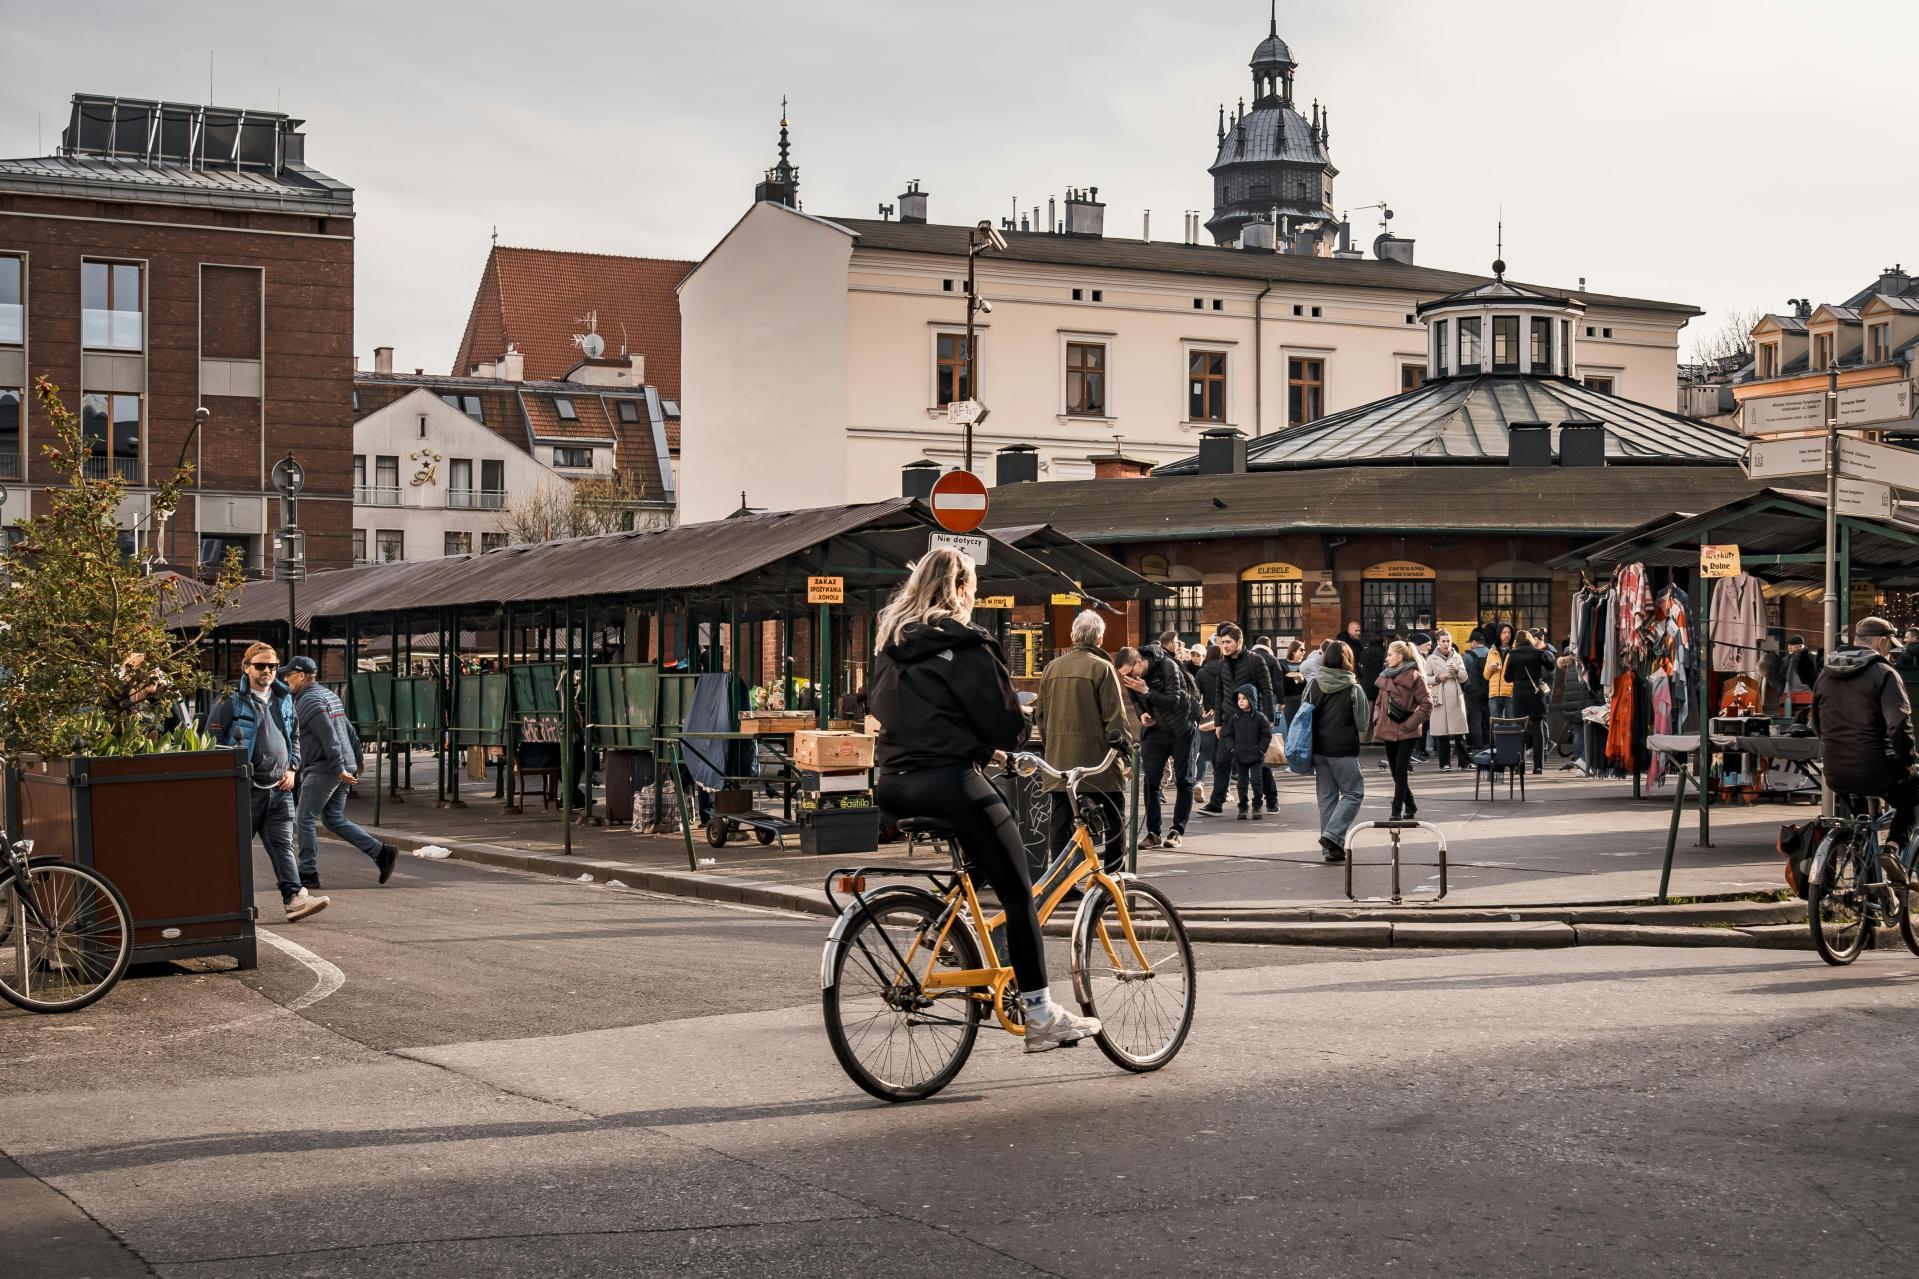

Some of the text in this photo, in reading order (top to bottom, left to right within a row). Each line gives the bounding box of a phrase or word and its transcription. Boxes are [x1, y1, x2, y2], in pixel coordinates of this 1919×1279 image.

[937, 534, 982, 547] Nie dotyczy
[1710, 562, 1731, 570] Rolne
